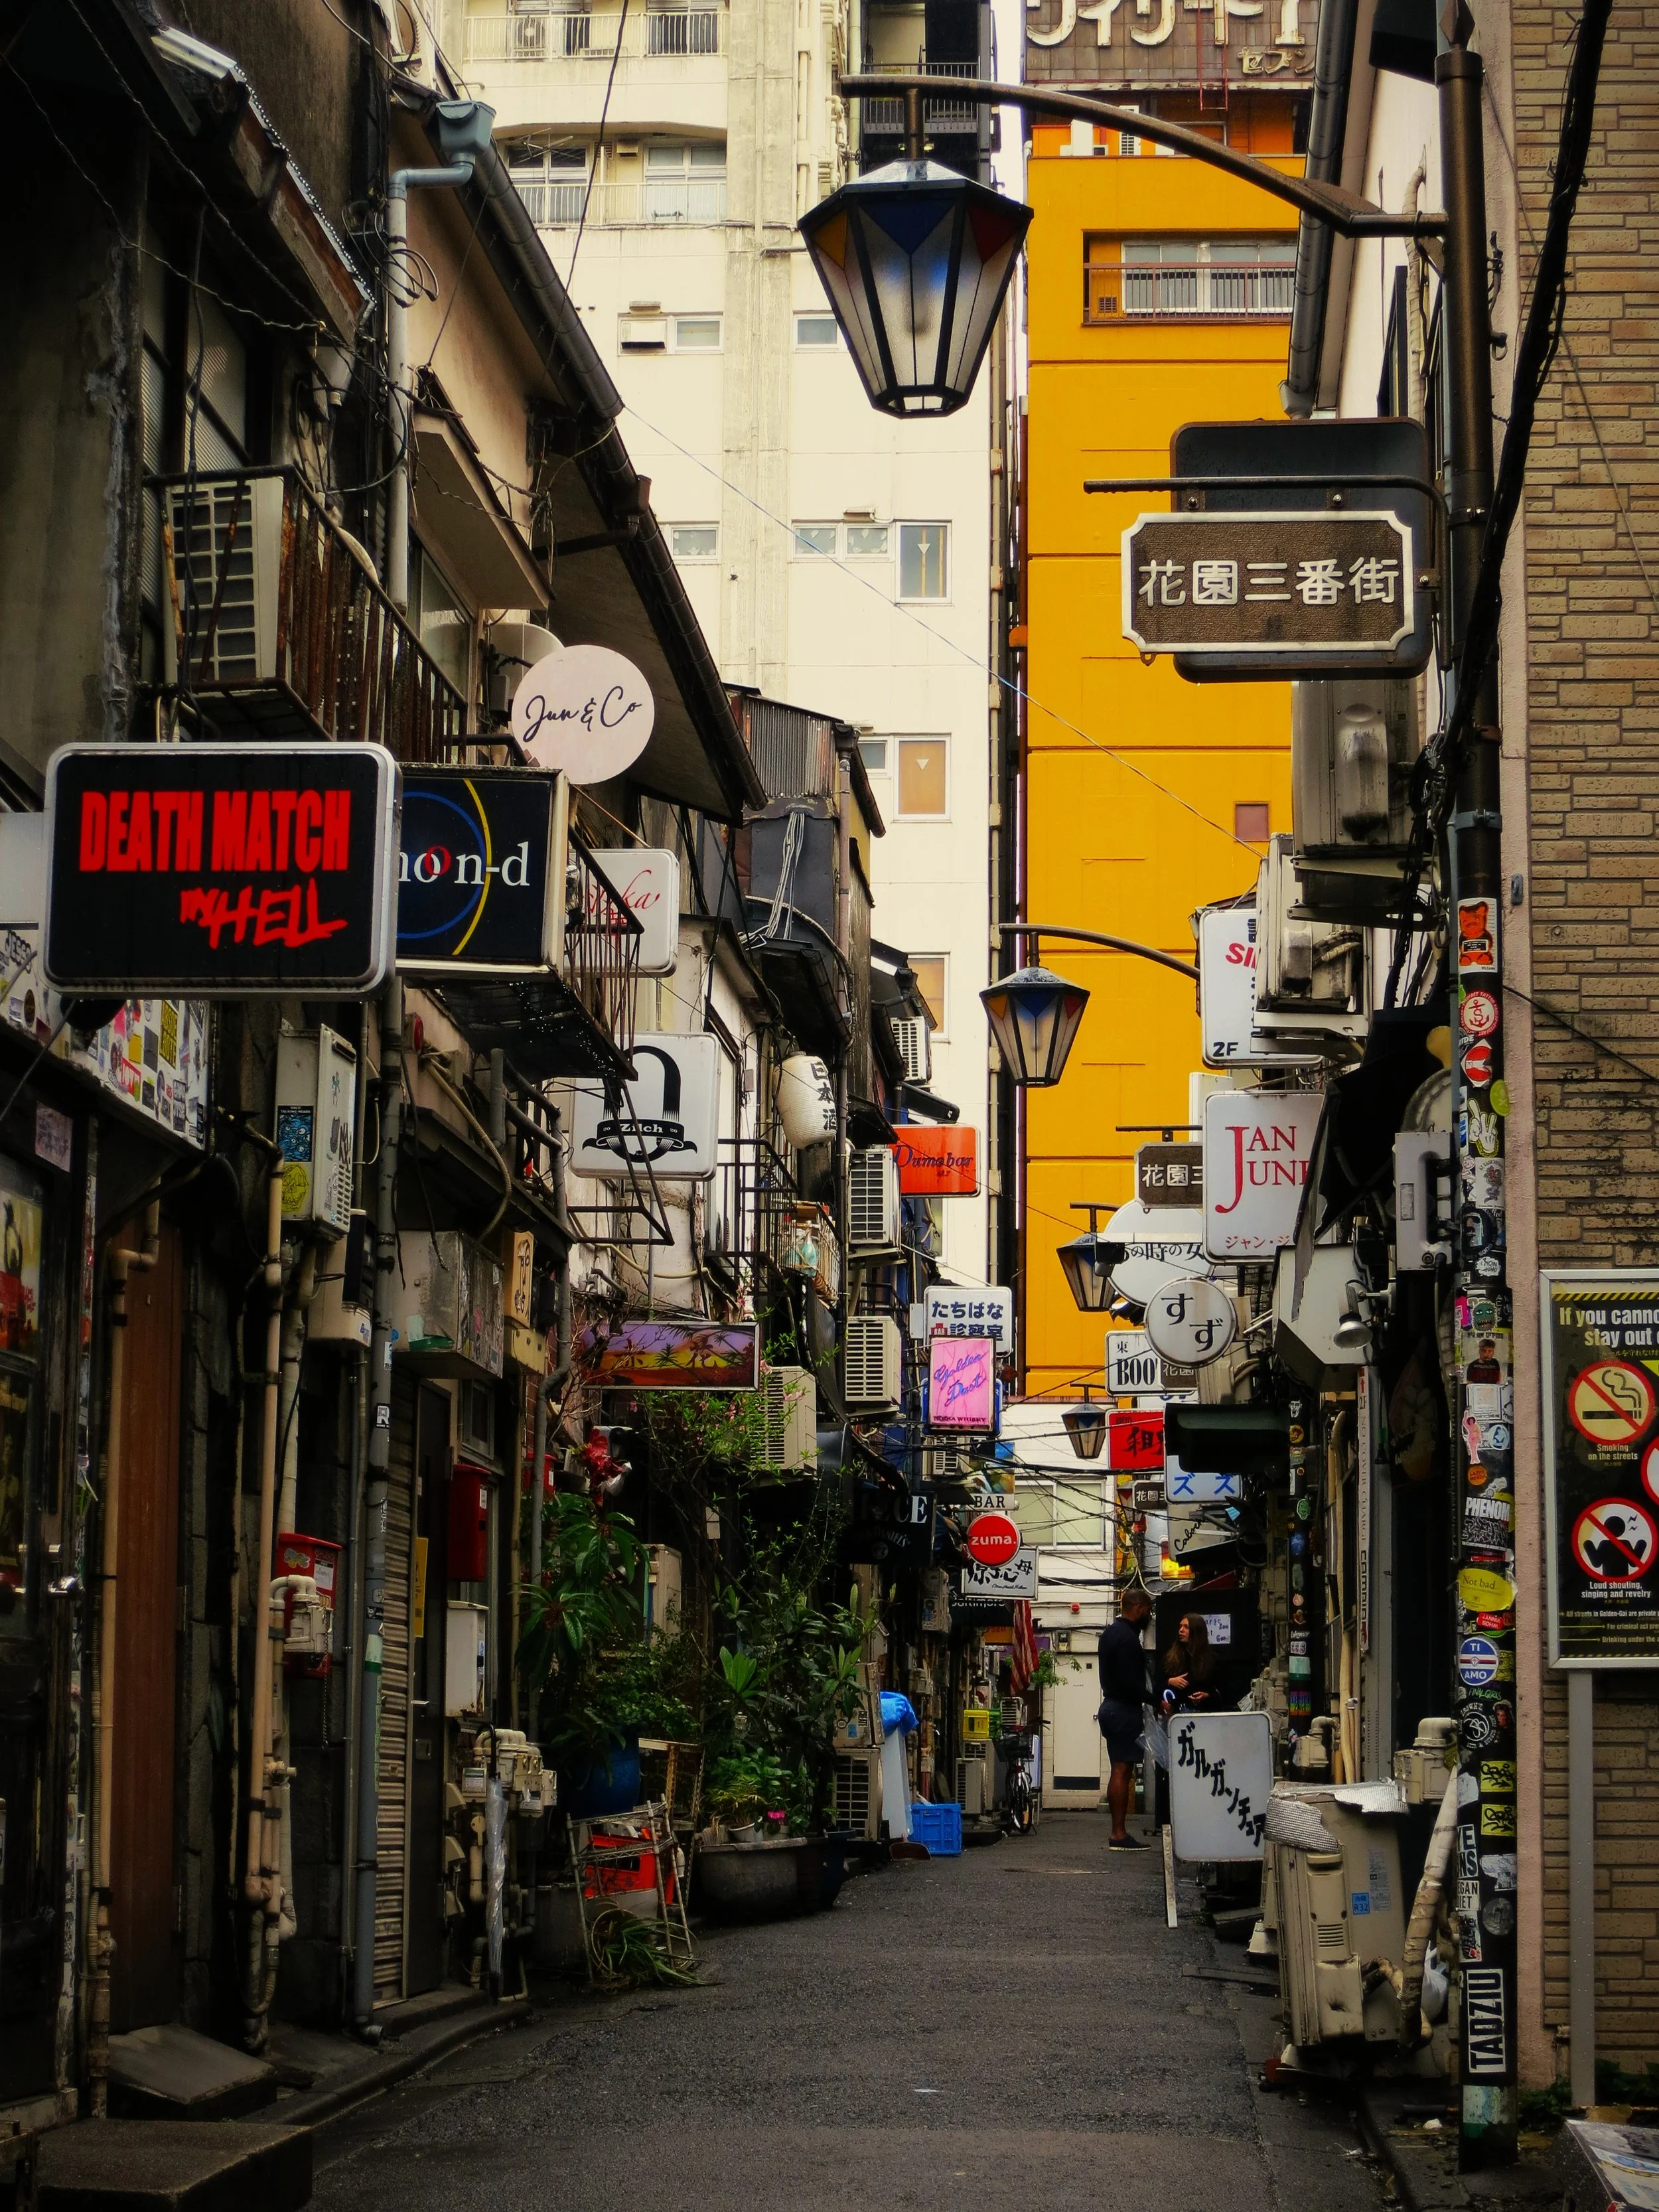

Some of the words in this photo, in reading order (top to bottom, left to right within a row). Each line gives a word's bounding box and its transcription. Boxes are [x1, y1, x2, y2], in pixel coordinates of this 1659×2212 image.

[1138, 556, 1400, 608] 花園三番街
[522, 694, 579, 742] Jun
[581, 698, 596, 732] &
[600, 686, 643, 728] Co
[78, 791, 203, 871] DEATH
[211, 790, 350, 873] MATCH
[204, 877, 348, 950] HELL
[1212, 1041, 1238, 1057] 2F
[810, 1062, 837, 1131] 日本酒
[620, 1124, 664, 1133] Zilch
[932, 1301, 1004, 1320] たちばな
[1559, 1307, 1571, 1325] If
[1576, 1309, 1606, 1327] you
[1585, 1328, 1620, 1349] stay
[1624, 1327, 1652, 1346] out
[934, 1351, 989, 1390] Golden
[1116, 1358, 1158, 1386] BOO
[1597, 1443, 1629, 1452] Smoking
[974, 1495, 1005, 1508] BAR
[971, 1534, 1017, 1546] zuma.
[1463, 1575, 1477, 1586] Not
[1479, 1578, 1498, 1590] bad.
[1581, 1590, 1608, 1599] singing
[1625, 1590, 1651, 1599] revelry
[1470, 1643, 1480, 1652] TI
[1465, 1670, 1487, 1680] AMO
[1459, 1881, 1478, 1895] EGAN
[1354, 1903, 1368, 1911] R32
[1468, 1972, 1506, 2070] TADZIU
